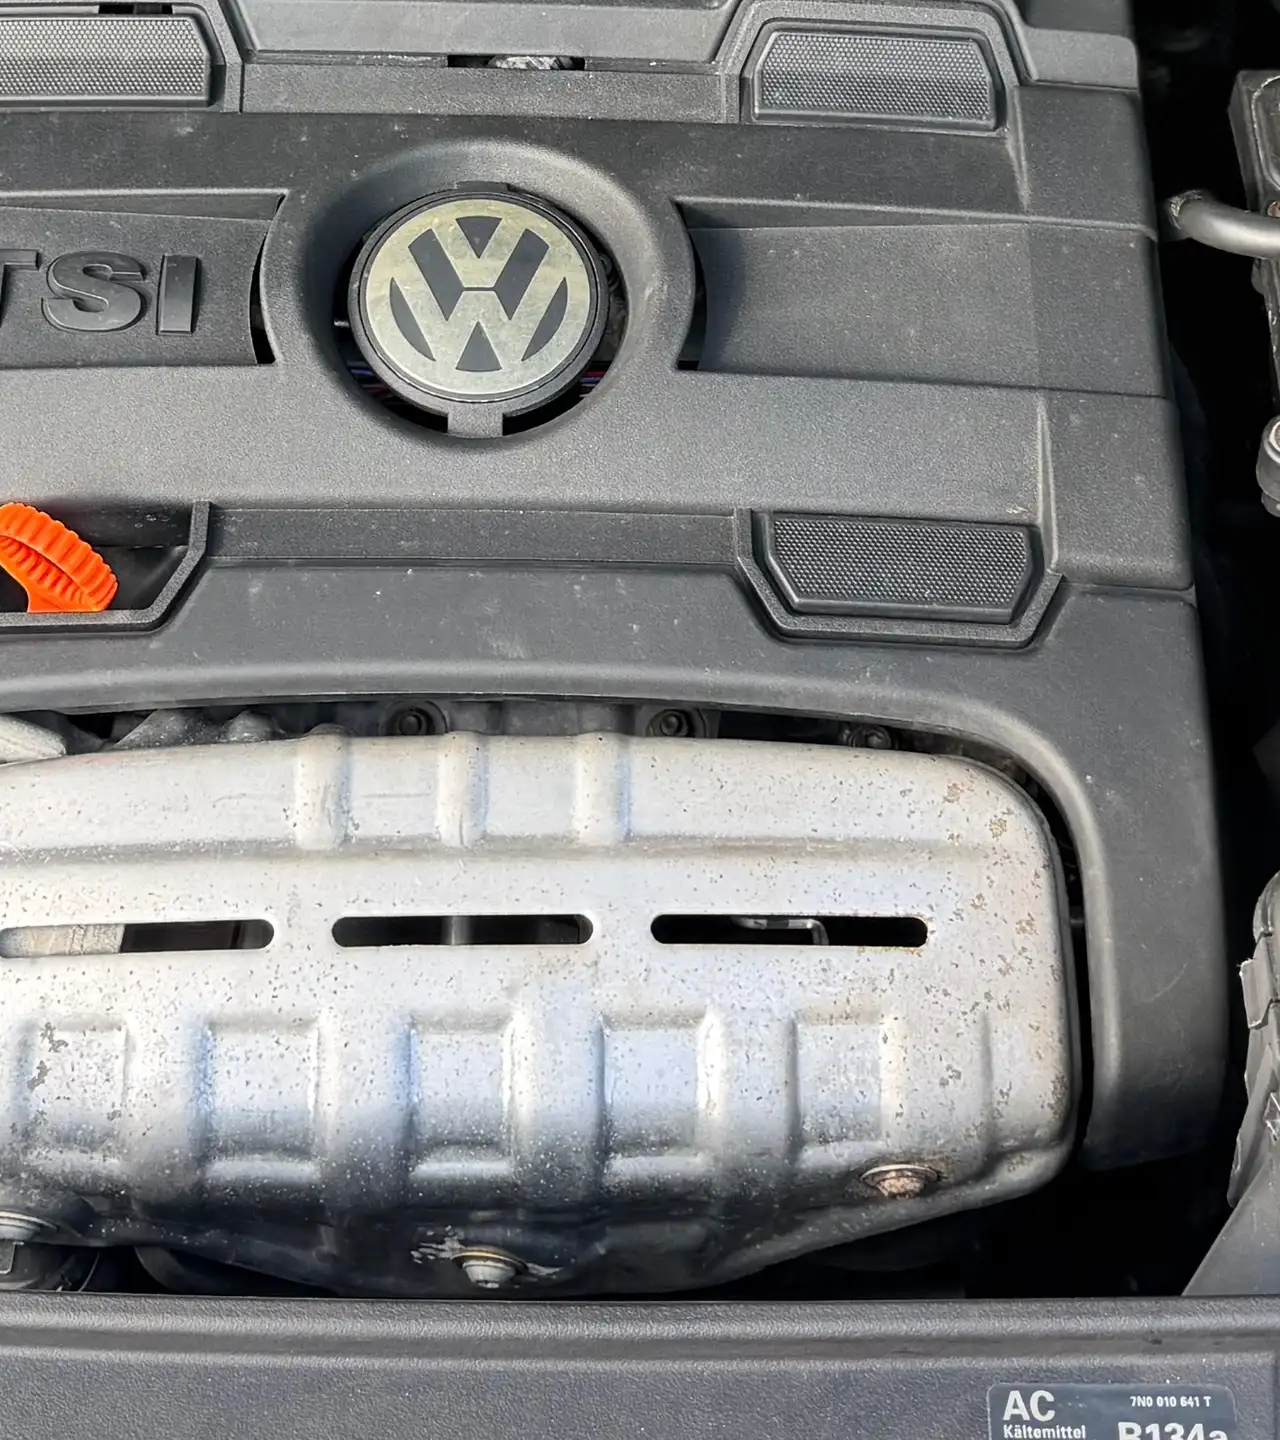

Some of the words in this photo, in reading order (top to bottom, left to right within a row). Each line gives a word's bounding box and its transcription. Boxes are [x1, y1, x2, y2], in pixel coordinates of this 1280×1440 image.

[1002, 1389, 1056, 1422] AC
[1130, 1396, 1153, 1408] 7N0
[1156, 1396, 1177, 1407] 010
[1179, 1396, 1200, 1408] 641
[1202, 1396, 1212, 1407] T
[1002, 1424, 1086, 1439] Kältemittel
